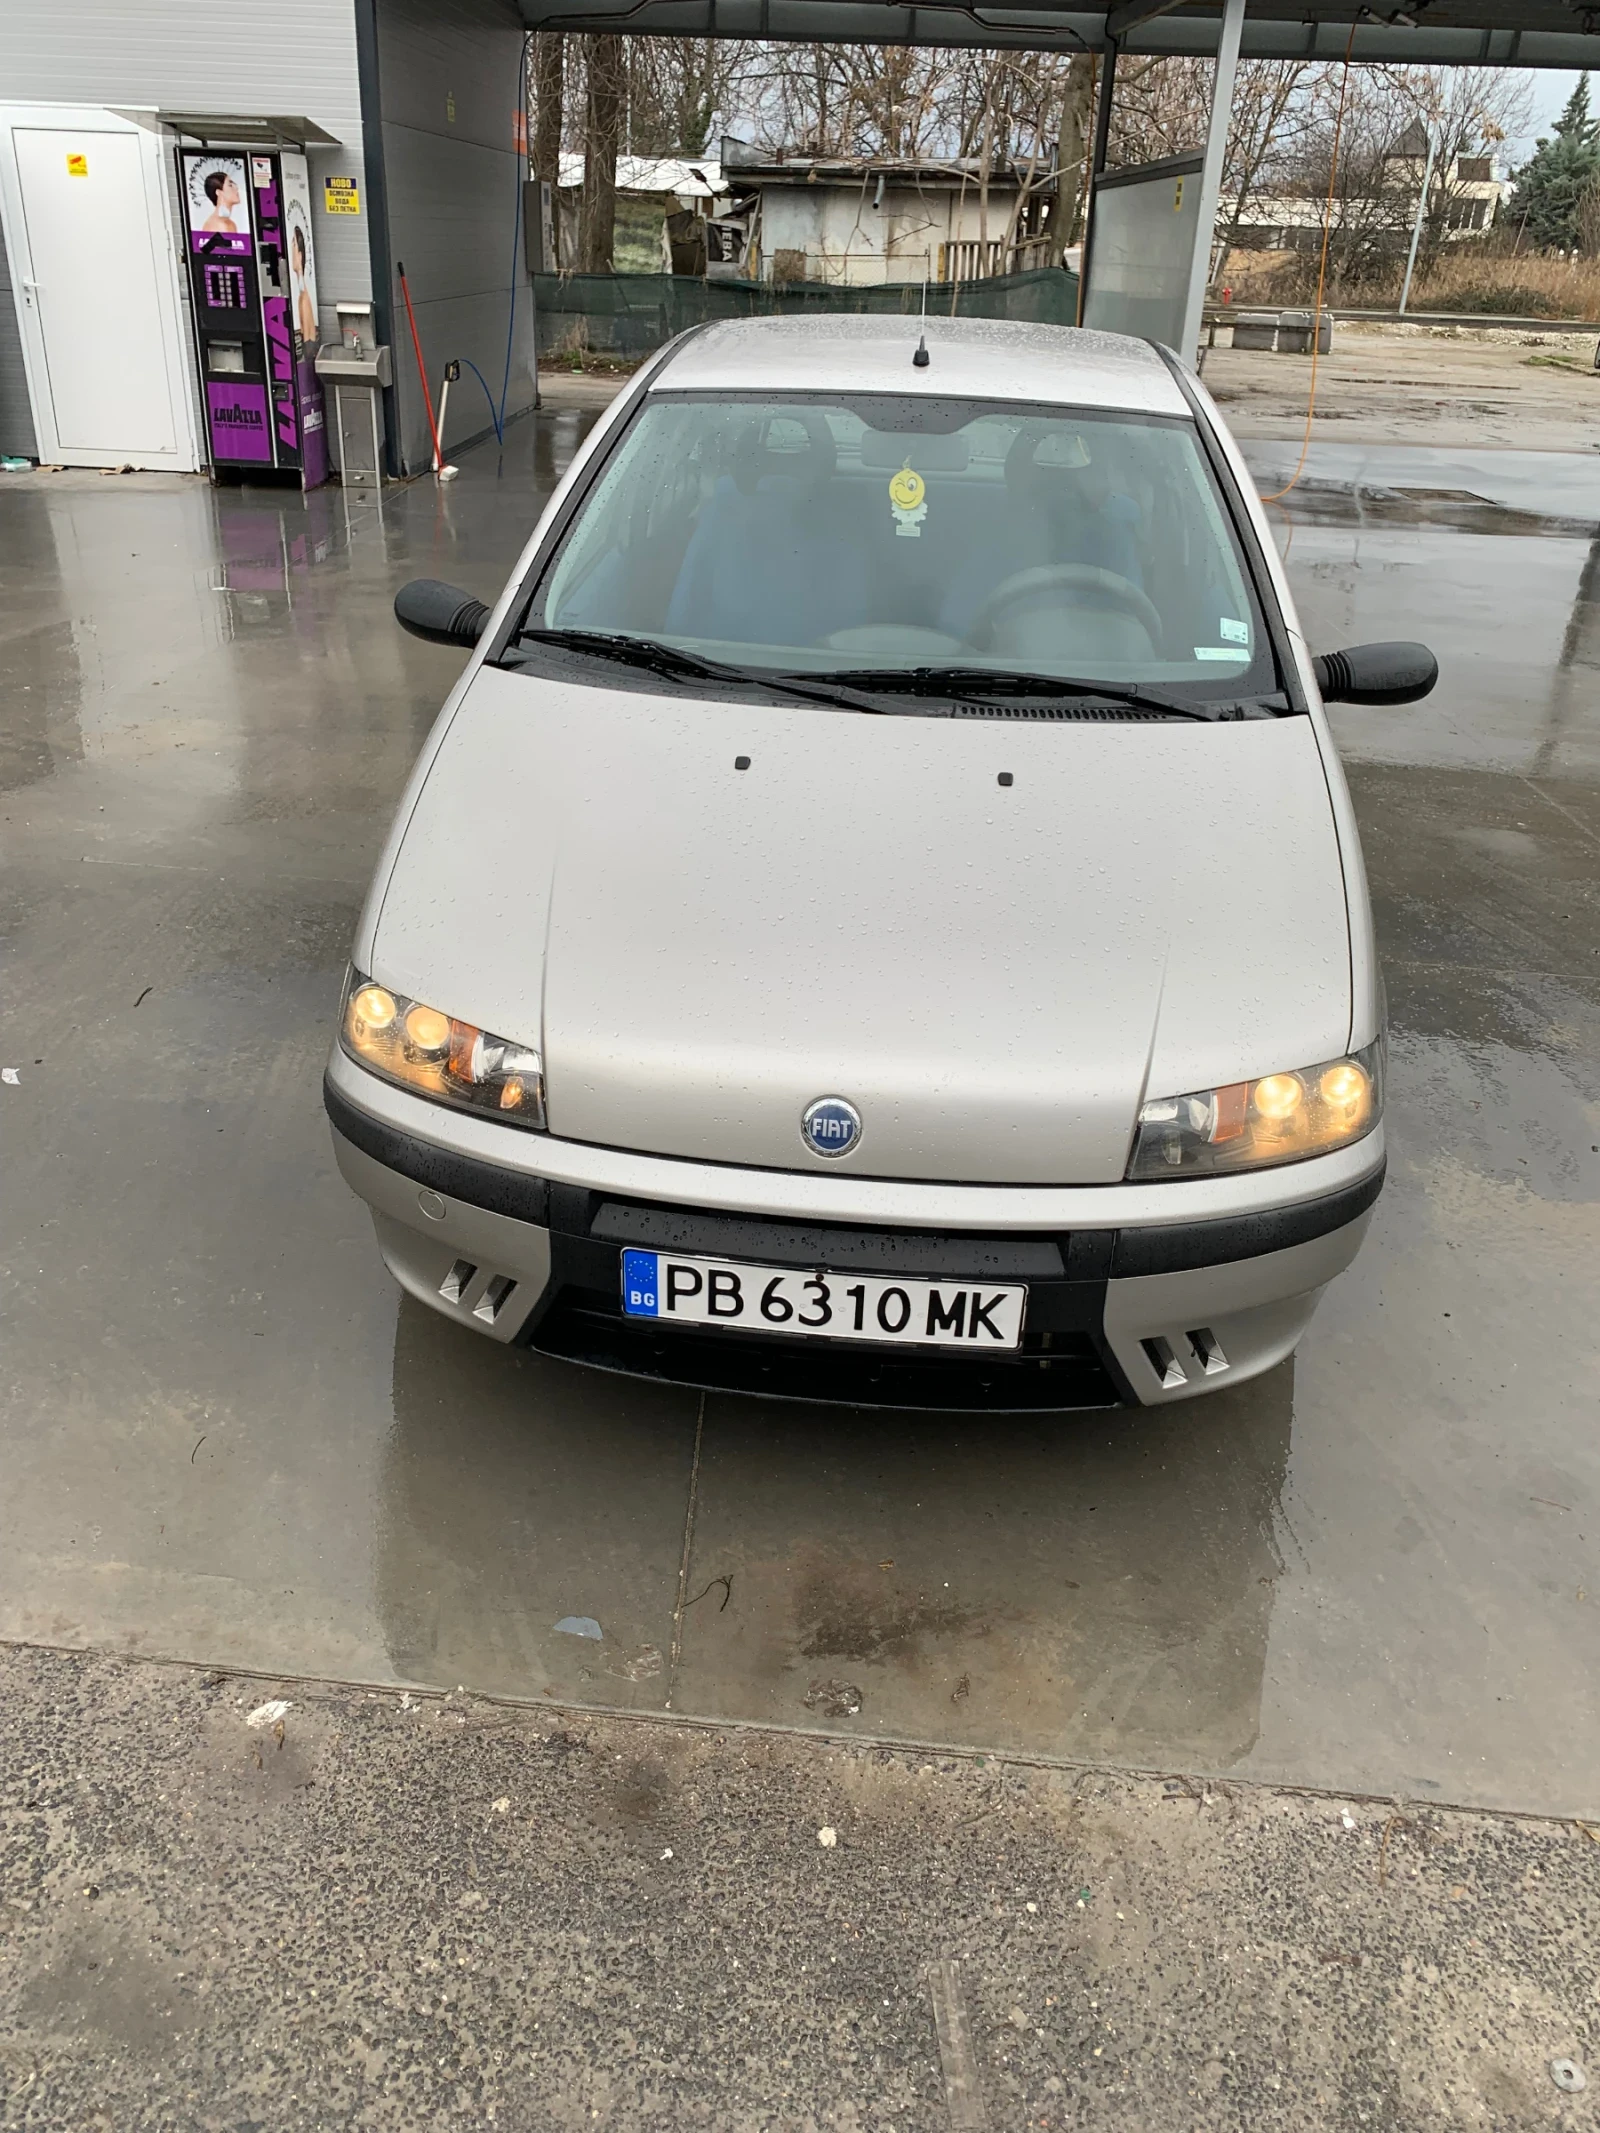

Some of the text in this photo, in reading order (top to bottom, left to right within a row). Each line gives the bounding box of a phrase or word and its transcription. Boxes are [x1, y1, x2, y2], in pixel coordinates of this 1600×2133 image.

[330, 178, 352, 188] НОВО
[213, 403, 263, 424] LAVAZZA
[812, 1118, 851, 1138] FIAT
[630, 1290, 655, 1307] BG
[667, 1264, 1009, 1340] PB 6310 MK
